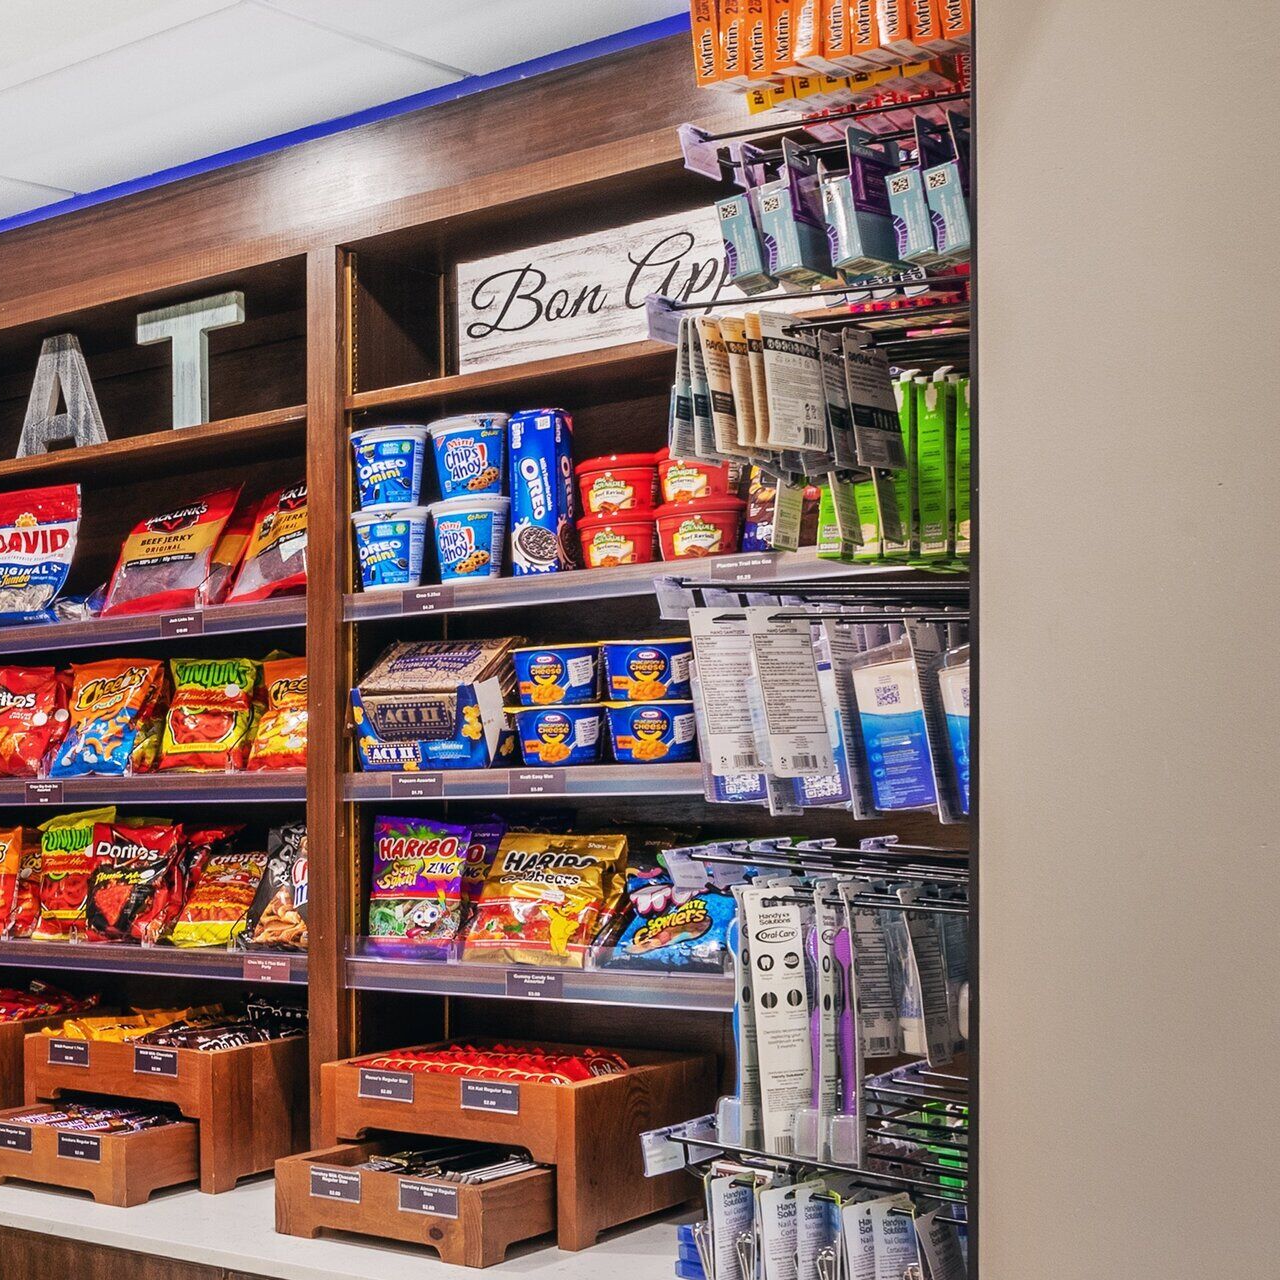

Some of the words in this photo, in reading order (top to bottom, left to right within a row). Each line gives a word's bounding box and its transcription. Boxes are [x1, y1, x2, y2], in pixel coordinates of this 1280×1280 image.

[776, 10, 789, 62] Motrin
[700, 30, 712, 77] Motrin
[724, 23, 738, 72] Motrin
[750, 22, 763, 73] Motrin
[466, 263, 609, 339] Bon
[447, 437, 475, 448] Mini
[444, 447, 479, 469] Chips
[360, 459, 406, 479] OREO
[369, 469, 401, 484] mini
[520, 457, 546, 521] OREO
[141, 538, 163, 546] BEEF
[164, 534, 194, 543] JERKY
[145, 544, 181, 553] ORIGINAL
[360, 540, 403, 558] OREO
[0, 574, 31, 587] Jumbo
[385, 708, 416, 723] ACT
[419, 708, 439, 721] II
[372, 748, 398, 759] ACT
[398, 748, 415, 758] II
[96, 842, 159, 861] Doritos
[379, 838, 458, 860] HARIBO
[392, 861, 416, 876] Sour
[758, 912, 781, 921] Handy
[420, 1185, 438, 1193] Almond
[882, 1226, 908, 1235] Solutions
